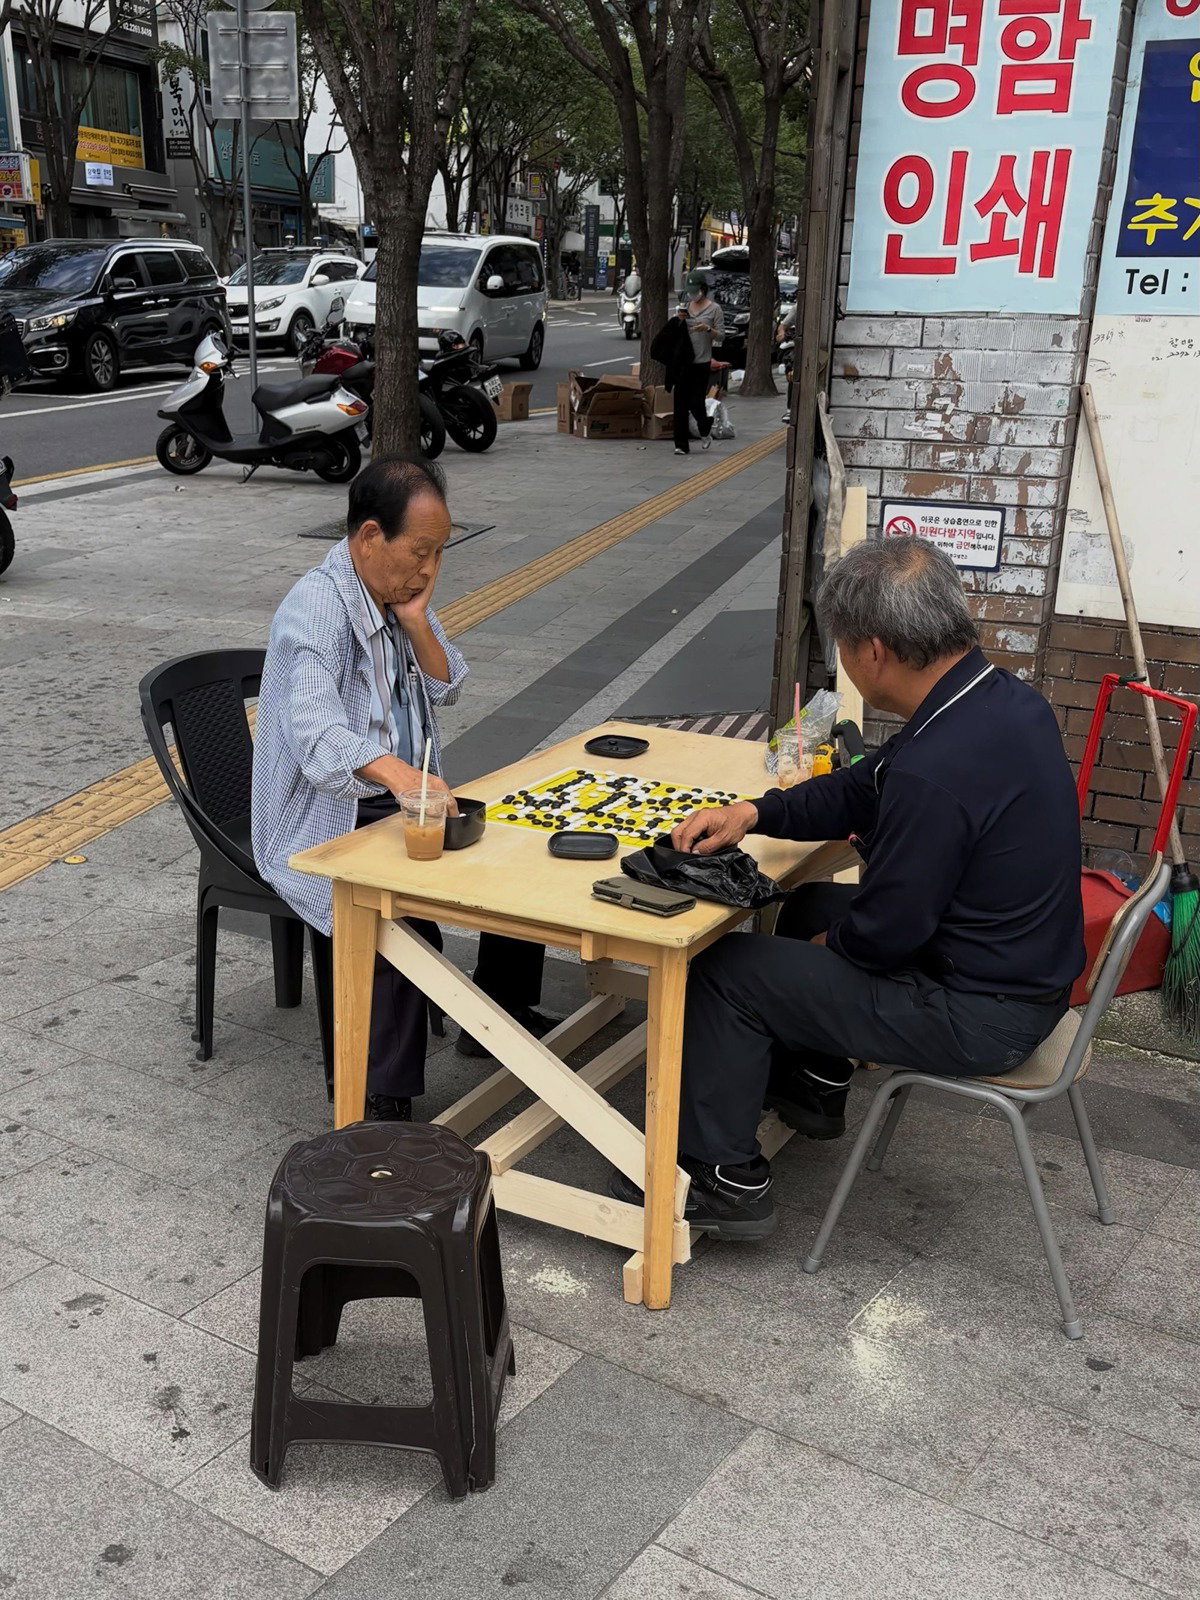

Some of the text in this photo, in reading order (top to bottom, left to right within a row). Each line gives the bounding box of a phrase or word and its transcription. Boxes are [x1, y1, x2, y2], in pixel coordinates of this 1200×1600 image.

[897, 0, 1092, 118] 명함
[883, 149, 1072, 278] 인쇄
[1125, 268, 1169, 295] Tel
[921, 515, 998, 528] 이곳은 상습흡연으로 인한
